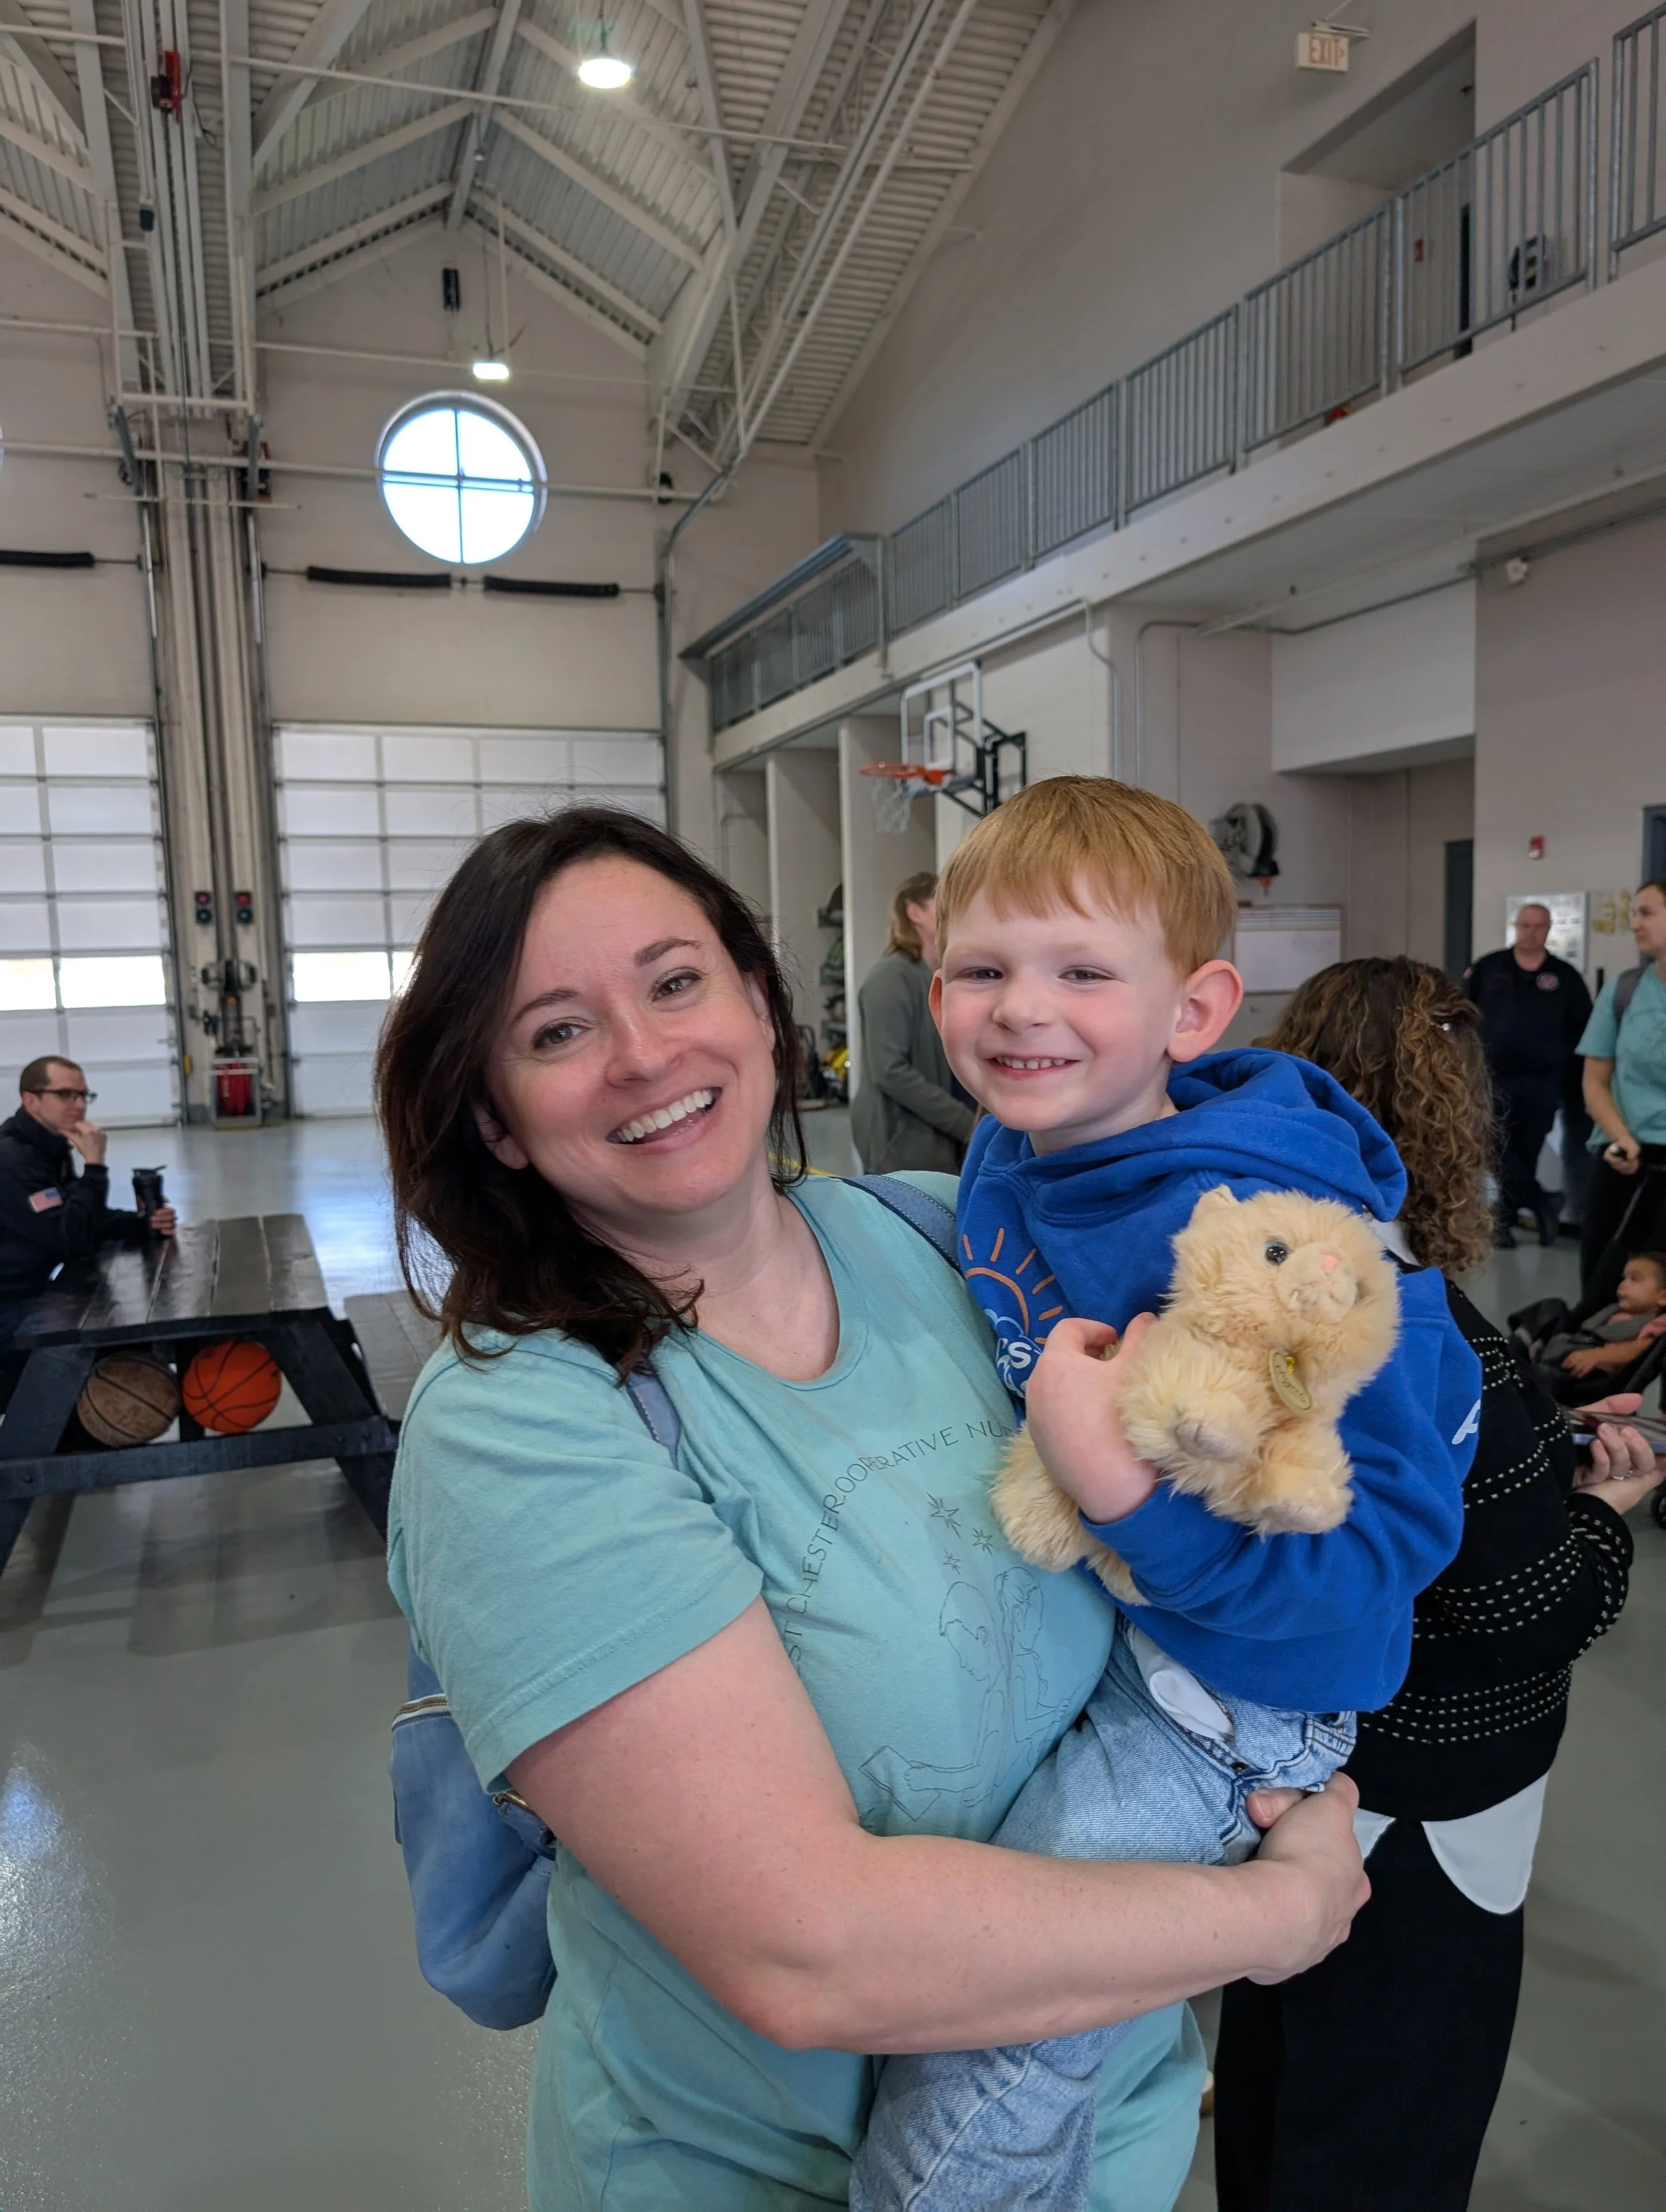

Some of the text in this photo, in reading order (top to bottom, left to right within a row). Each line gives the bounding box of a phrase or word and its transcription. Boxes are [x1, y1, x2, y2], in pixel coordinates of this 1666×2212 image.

[1308, 35, 1339, 66] EXIT
[786, 1494, 845, 1614] CHESTER
[835, 1426, 958, 1499] OOPERATIVE
